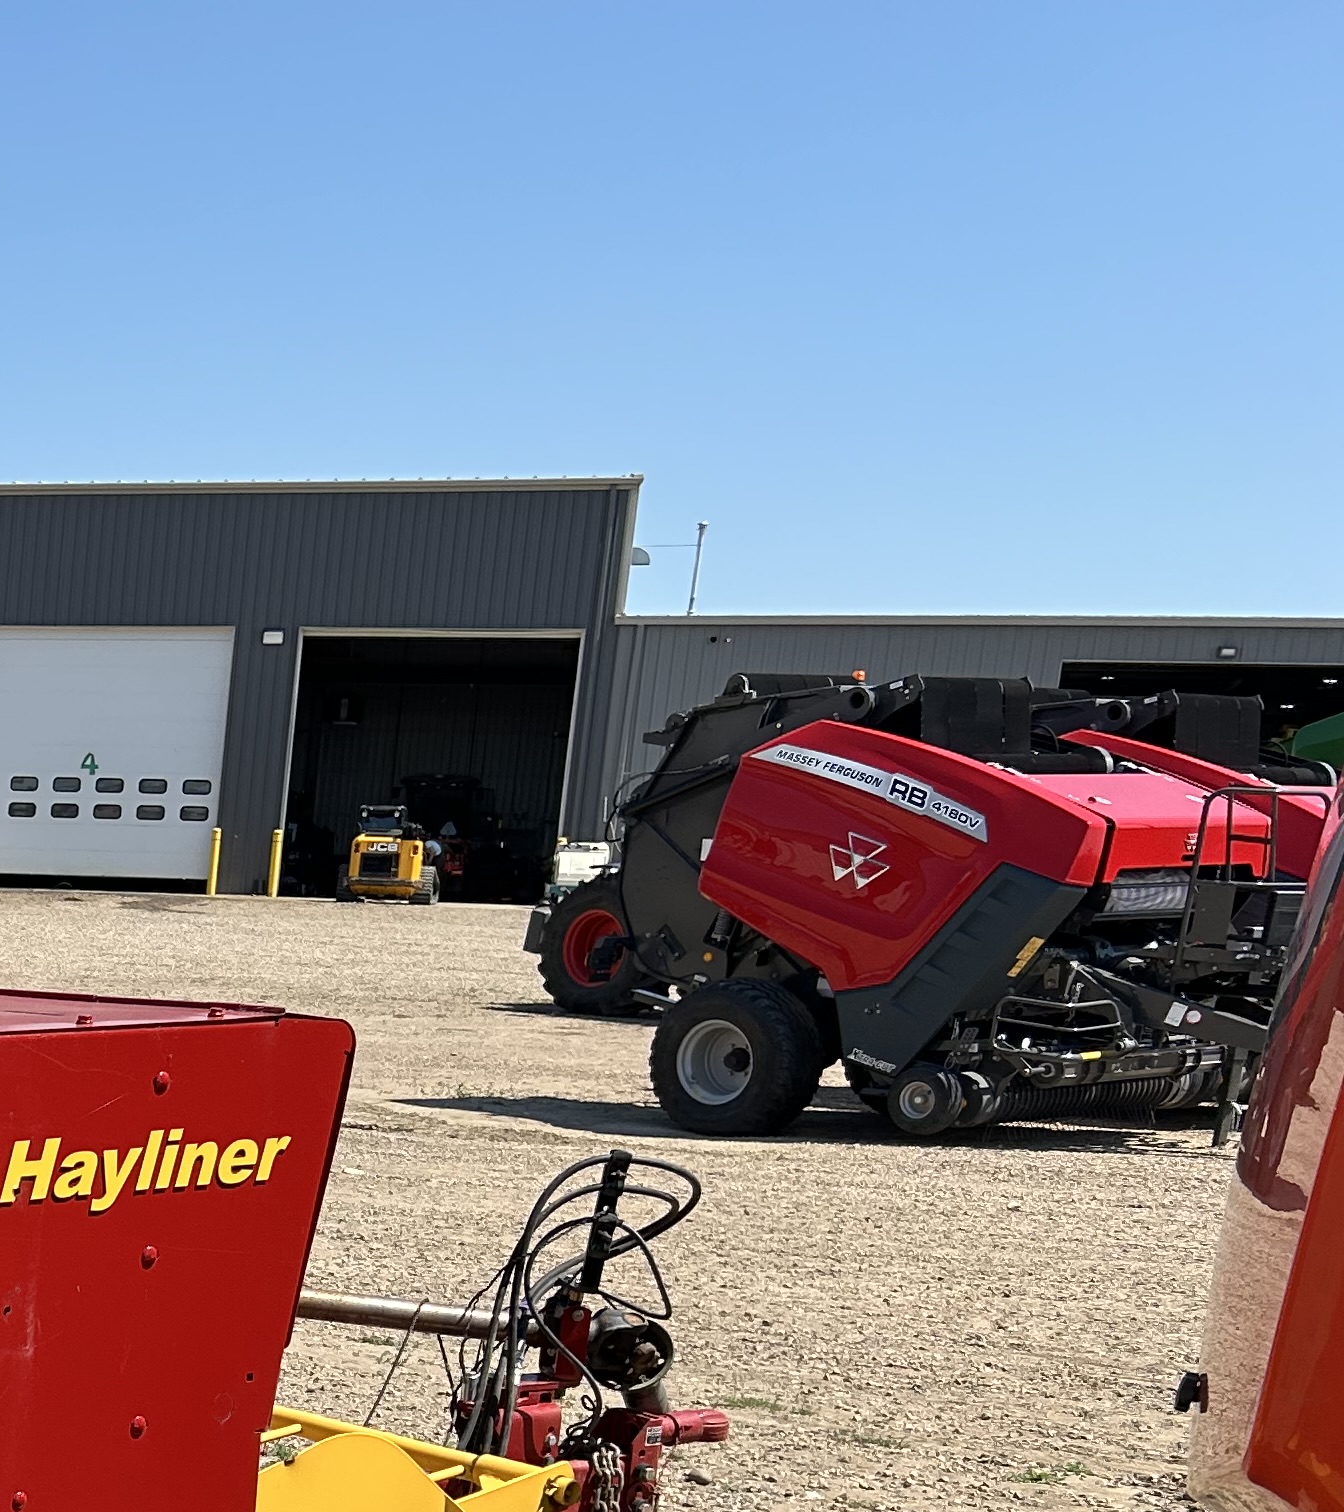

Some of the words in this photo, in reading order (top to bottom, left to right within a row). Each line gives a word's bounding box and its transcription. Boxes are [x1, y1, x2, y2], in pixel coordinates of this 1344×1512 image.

[80, 752, 99, 775] 4
[775, 749, 823, 768] MASSEY
[822, 761, 884, 788] FERGUSON
[888, 777, 929, 810] RB
[932, 801, 981, 829] 4180V
[368, 842, 399, 852] JCB
